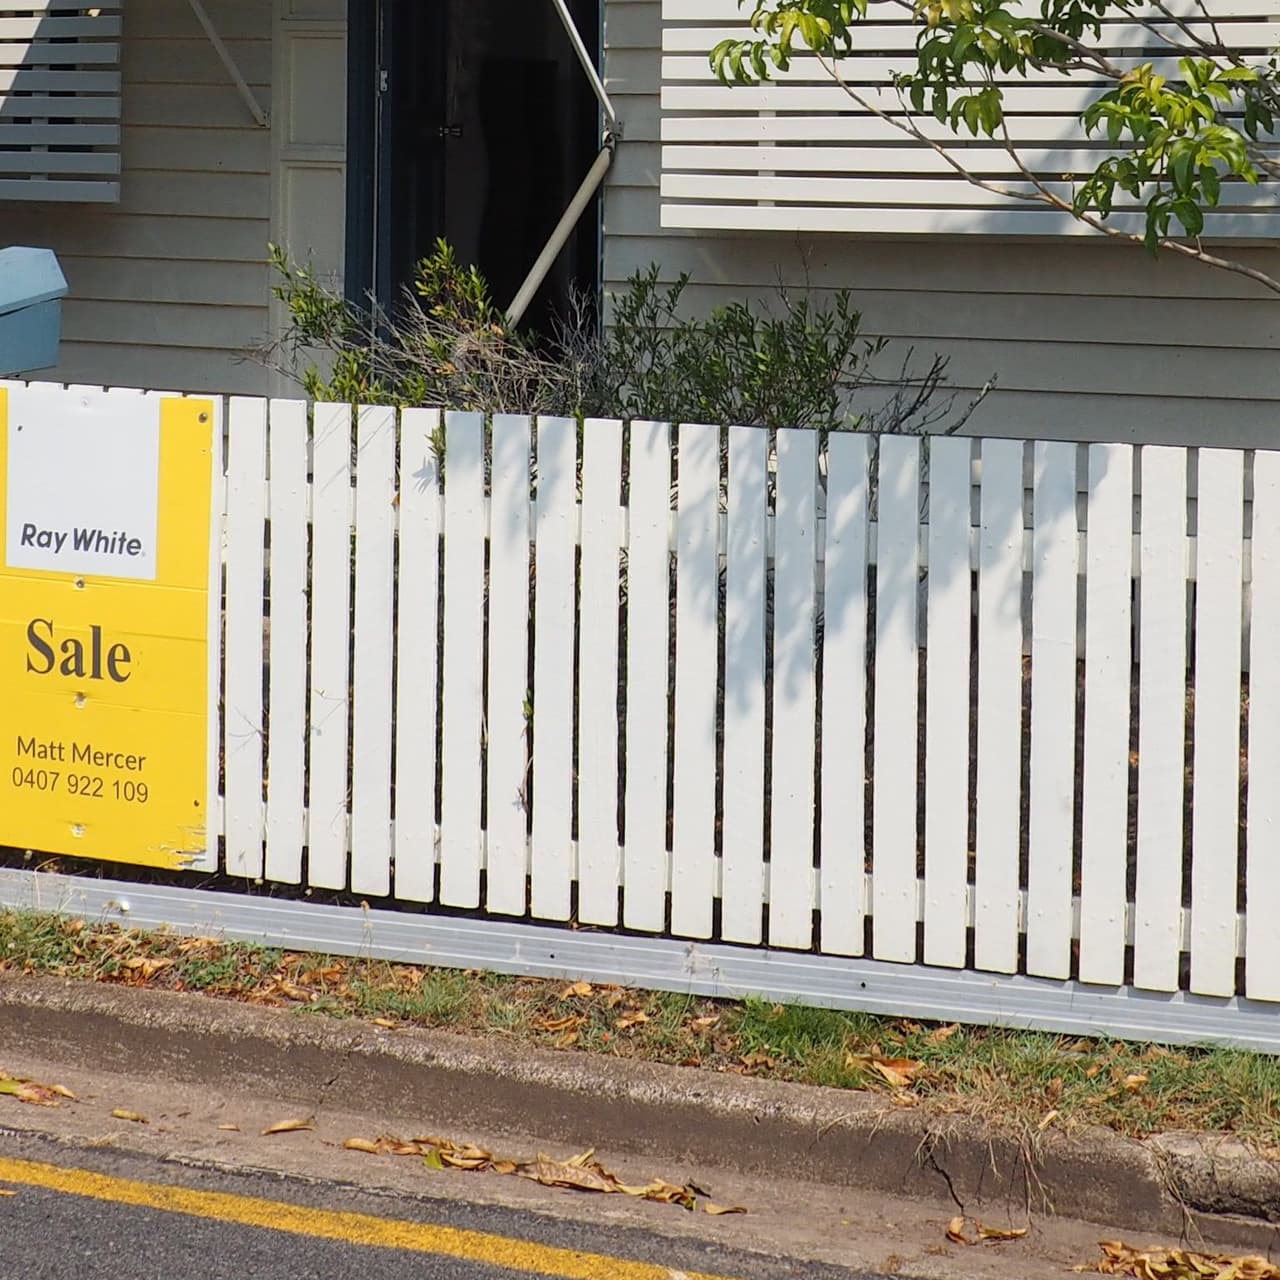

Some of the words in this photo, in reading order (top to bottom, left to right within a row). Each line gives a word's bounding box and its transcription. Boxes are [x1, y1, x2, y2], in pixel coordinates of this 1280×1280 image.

[20, 523, 68, 554] Ray
[73, 527, 142, 556] White
[26, 618, 131, 683] Sale
[16, 735, 65, 762] Matt
[72, 742, 146, 771] Mercer
[12, 766, 60, 792] 0407
[67, 774, 104, 798] 922
[112, 780, 148, 803] 109
